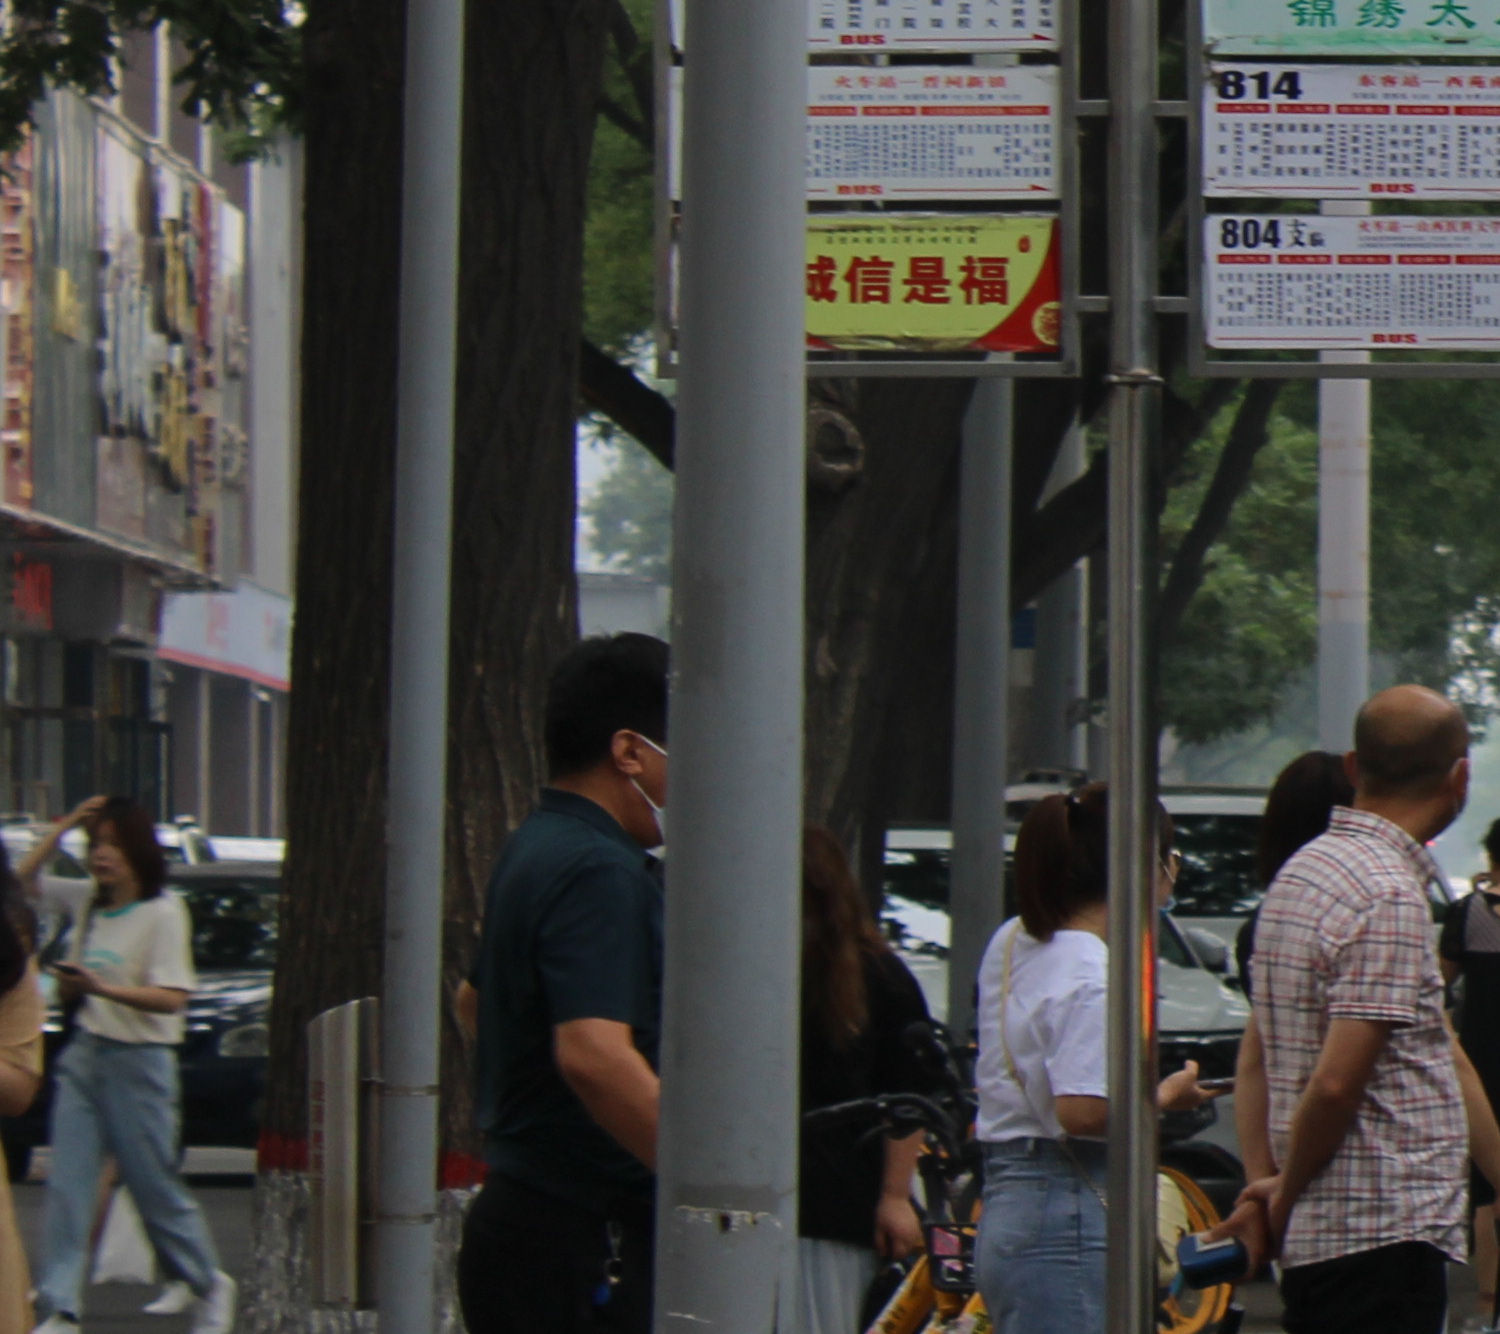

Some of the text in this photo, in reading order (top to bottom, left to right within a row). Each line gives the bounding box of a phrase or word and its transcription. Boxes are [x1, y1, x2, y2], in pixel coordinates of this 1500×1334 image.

[838, 34, 887, 46] BUS
[1216, 70, 1304, 101] 814
[836, 184, 884, 196] BUS
[1369, 182, 1416, 194] BUS
[1220, 219, 1281, 249] 804
[1372, 332, 1418, 344] BUS
